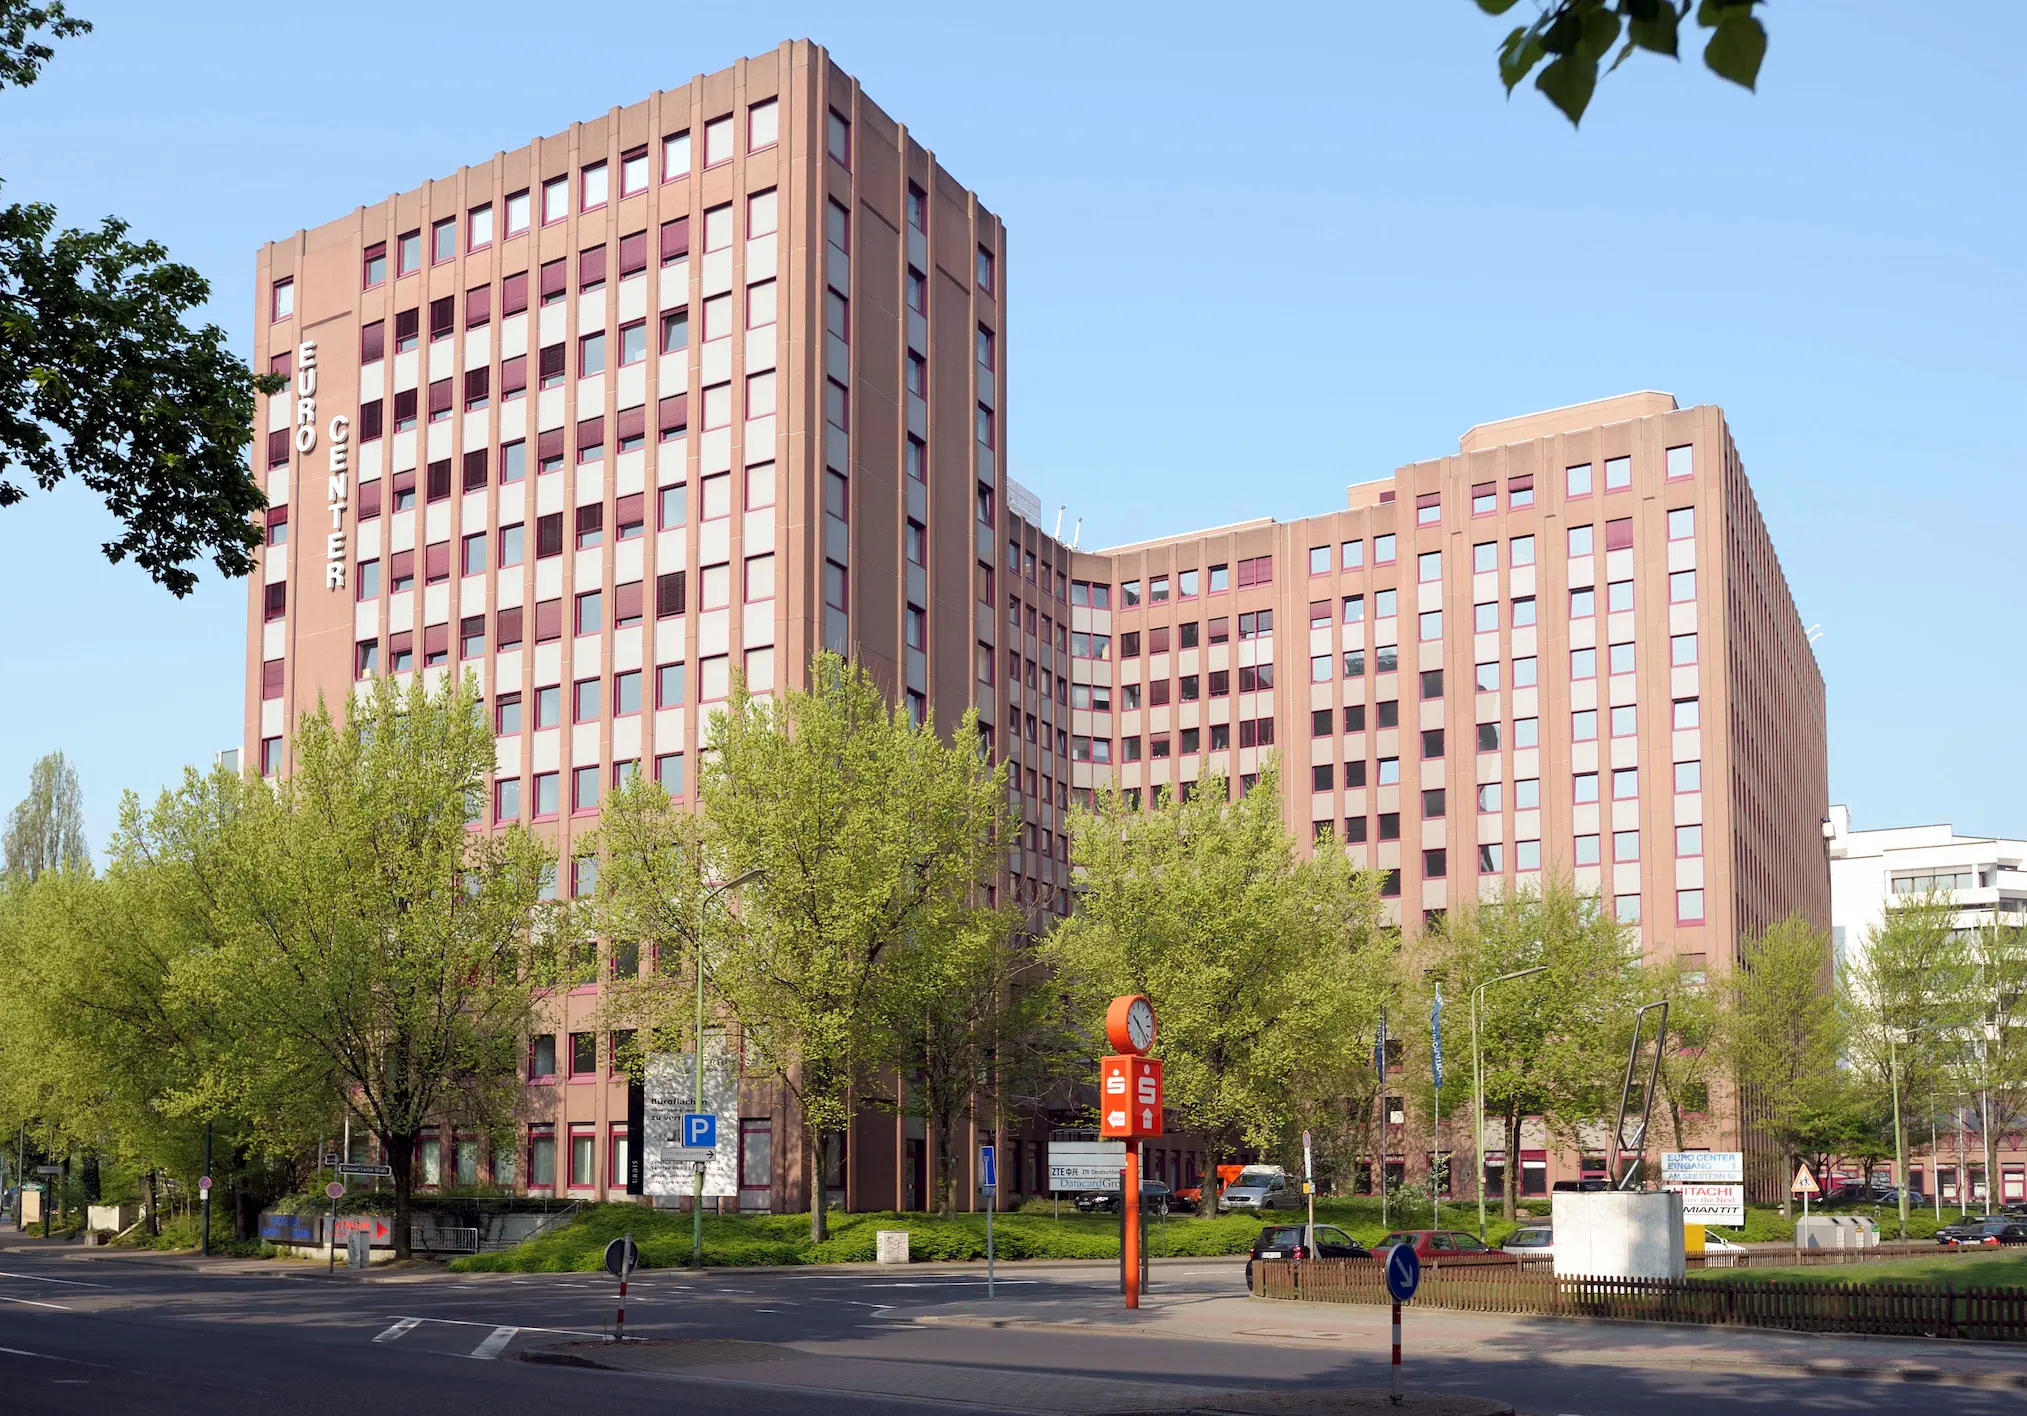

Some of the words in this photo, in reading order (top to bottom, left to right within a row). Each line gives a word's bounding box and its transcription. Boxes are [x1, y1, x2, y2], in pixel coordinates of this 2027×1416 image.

[296, 340, 318, 453] EURO
[325, 414, 350, 591] CENTER
[691, 1118, 709, 1143] P
[1051, 1168, 1065, 1176] ZTE
[1060, 1179, 1120, 1188] DatacardGro
